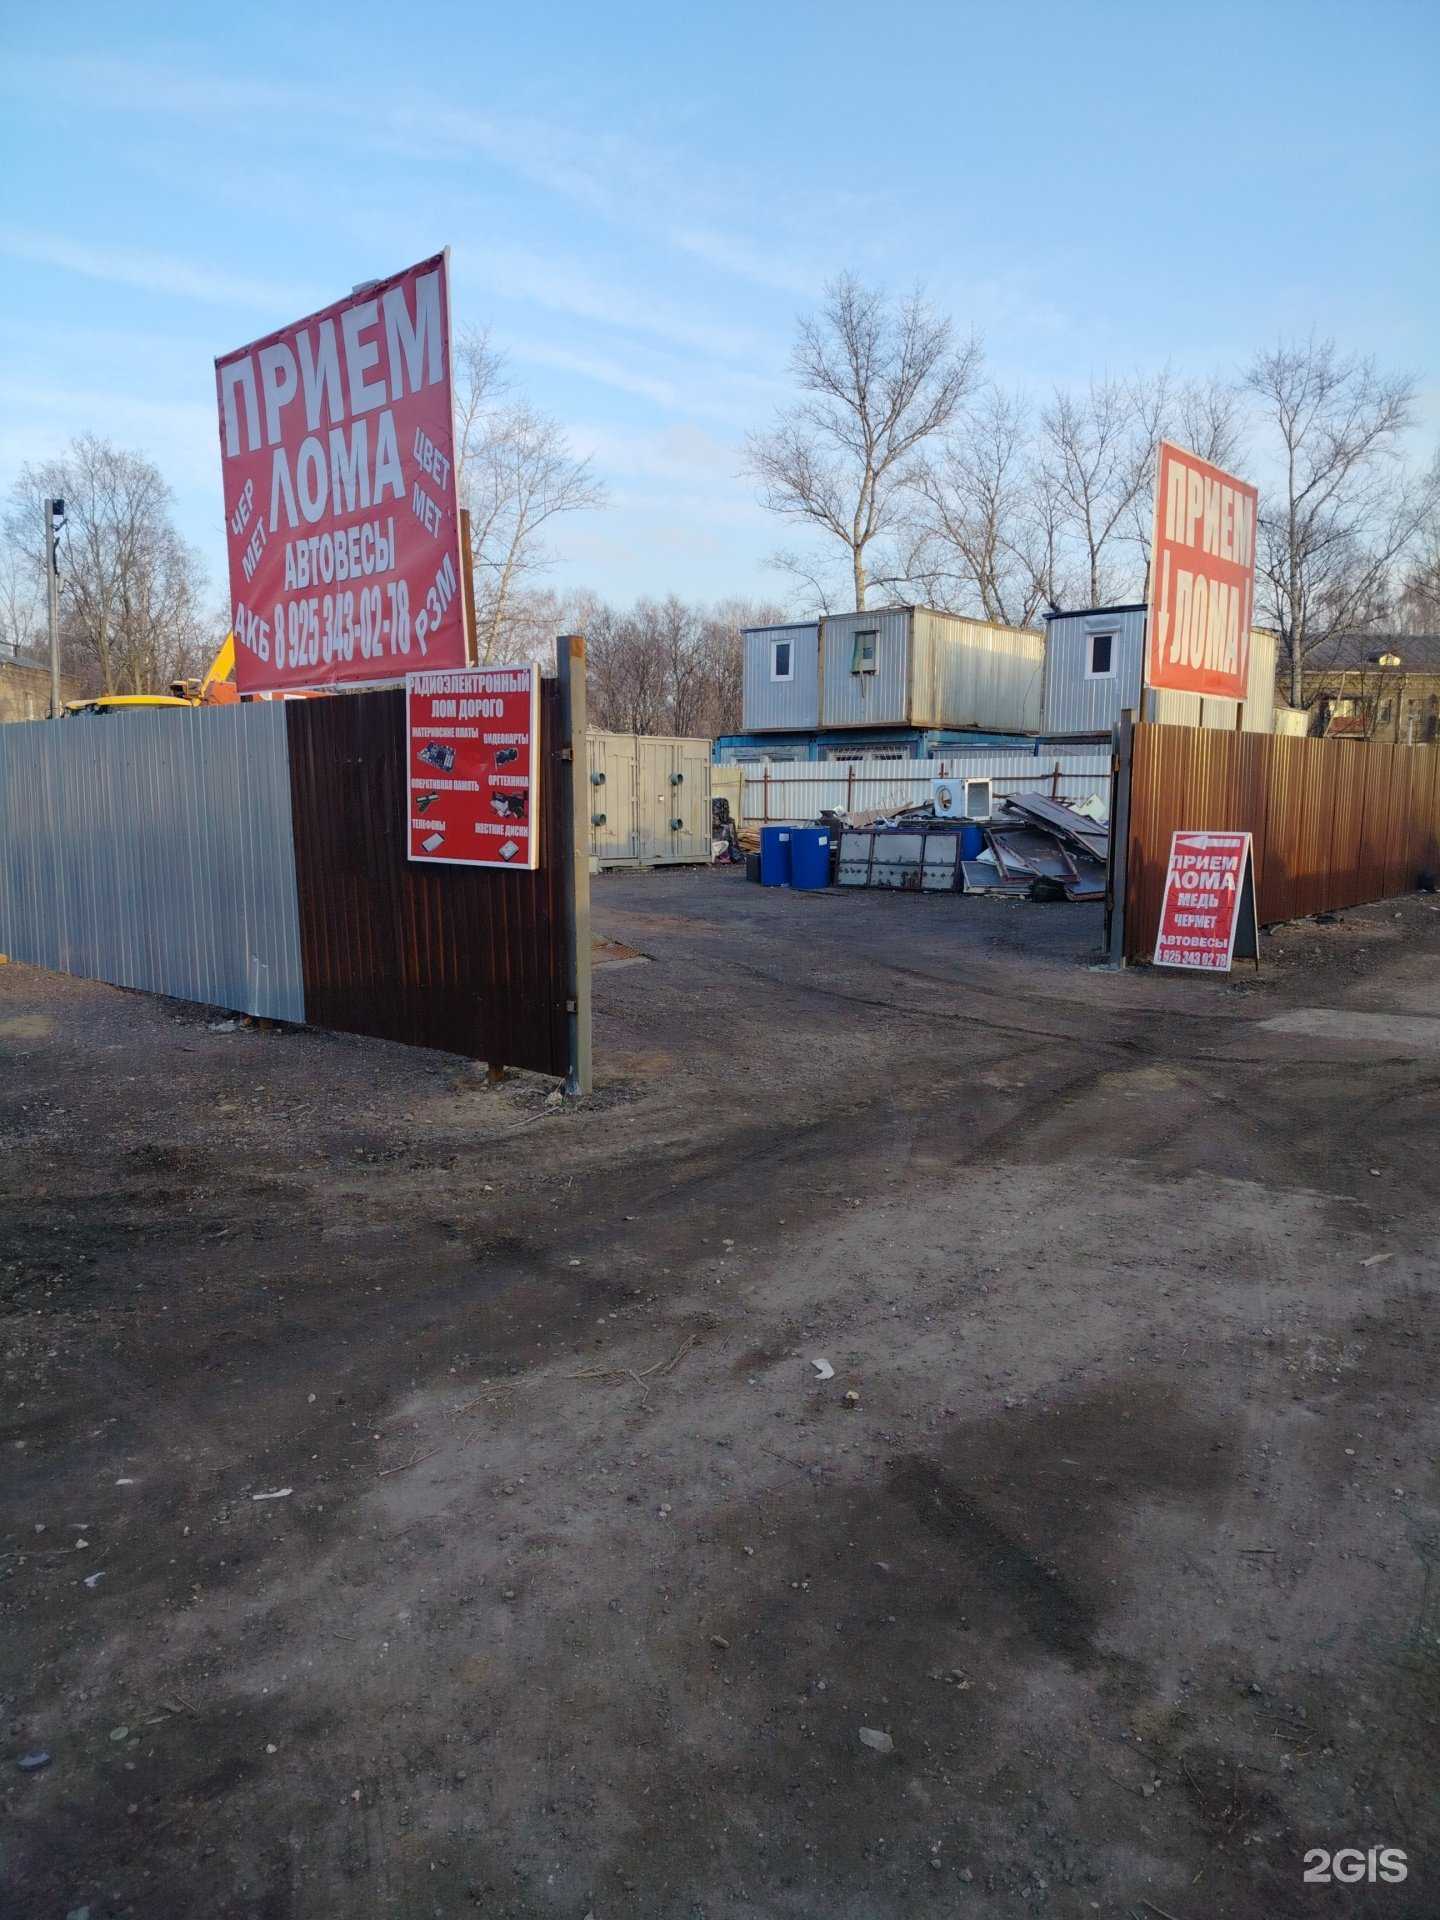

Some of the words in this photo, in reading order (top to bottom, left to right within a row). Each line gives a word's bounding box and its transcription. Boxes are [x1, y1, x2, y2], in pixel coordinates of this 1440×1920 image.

[220, 270, 443, 458] ПРИЕМ
[269, 410, 406, 532] ЛОМА
[413, 426, 450, 491] ЦВЕТ
[232, 479, 254, 536] ЧЕР
[412, 481, 442, 538] МЕТ
[1165, 458, 1253, 568] ПРИЕМ
[241, 516, 268, 583] МЕТ
[284, 517, 395, 591] АВТОВЕСЫ
[234, 602, 271, 662] АКБ
[274, 603, 285, 669] 8
[288, 597, 319, 668] 925
[323, 579, 411, 664] 343-02-78
[415, 552, 457, 656] РЗМ
[1169, 569, 1240, 675] ЛОМА
[409, 669, 530, 697] РАДИОЭЛЕКТРОННЫЙ
[432, 699, 456, 718] ЛОМ
[458, 699, 504, 720] ДОРОГО
[1167, 870, 1236, 890] ЛОМА
[1171, 855, 1239, 870] ПРИЕМ
[1175, 913, 1217, 928] ЧЕРМЕТ
[1178, 893, 1219, 909] МЕДЬ
[1160, 934, 1228, 948] АВТОВЕСЫ
